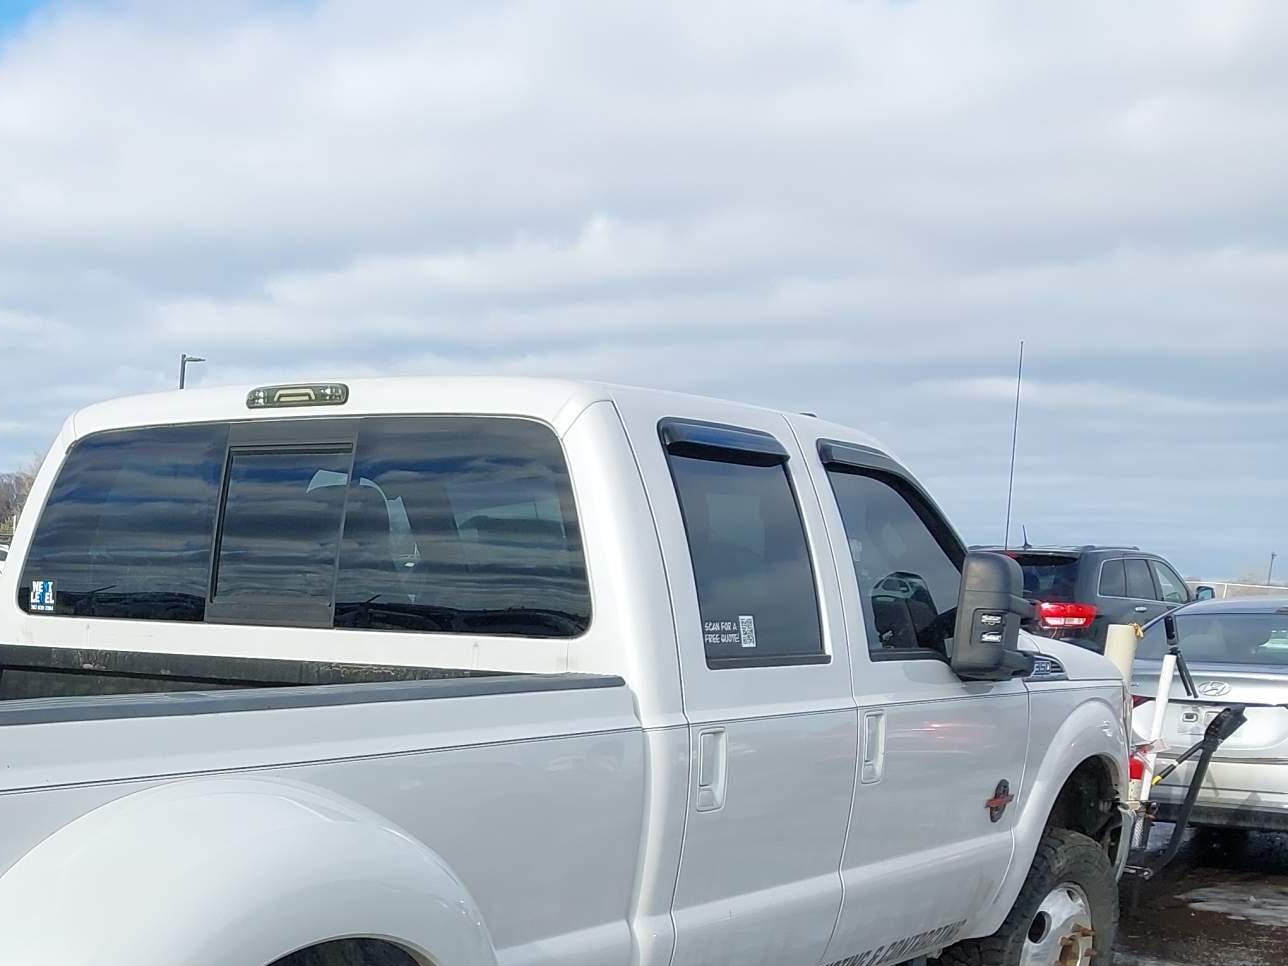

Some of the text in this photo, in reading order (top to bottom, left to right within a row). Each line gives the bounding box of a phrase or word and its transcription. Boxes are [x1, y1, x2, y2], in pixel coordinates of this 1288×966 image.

[32, 581, 53, 592] NEXT
[30, 592, 54, 604] LEVEL
[704, 622, 720, 631] SCAN
[721, 622, 732, 630] FOR
[704, 634, 720, 643] FREE
